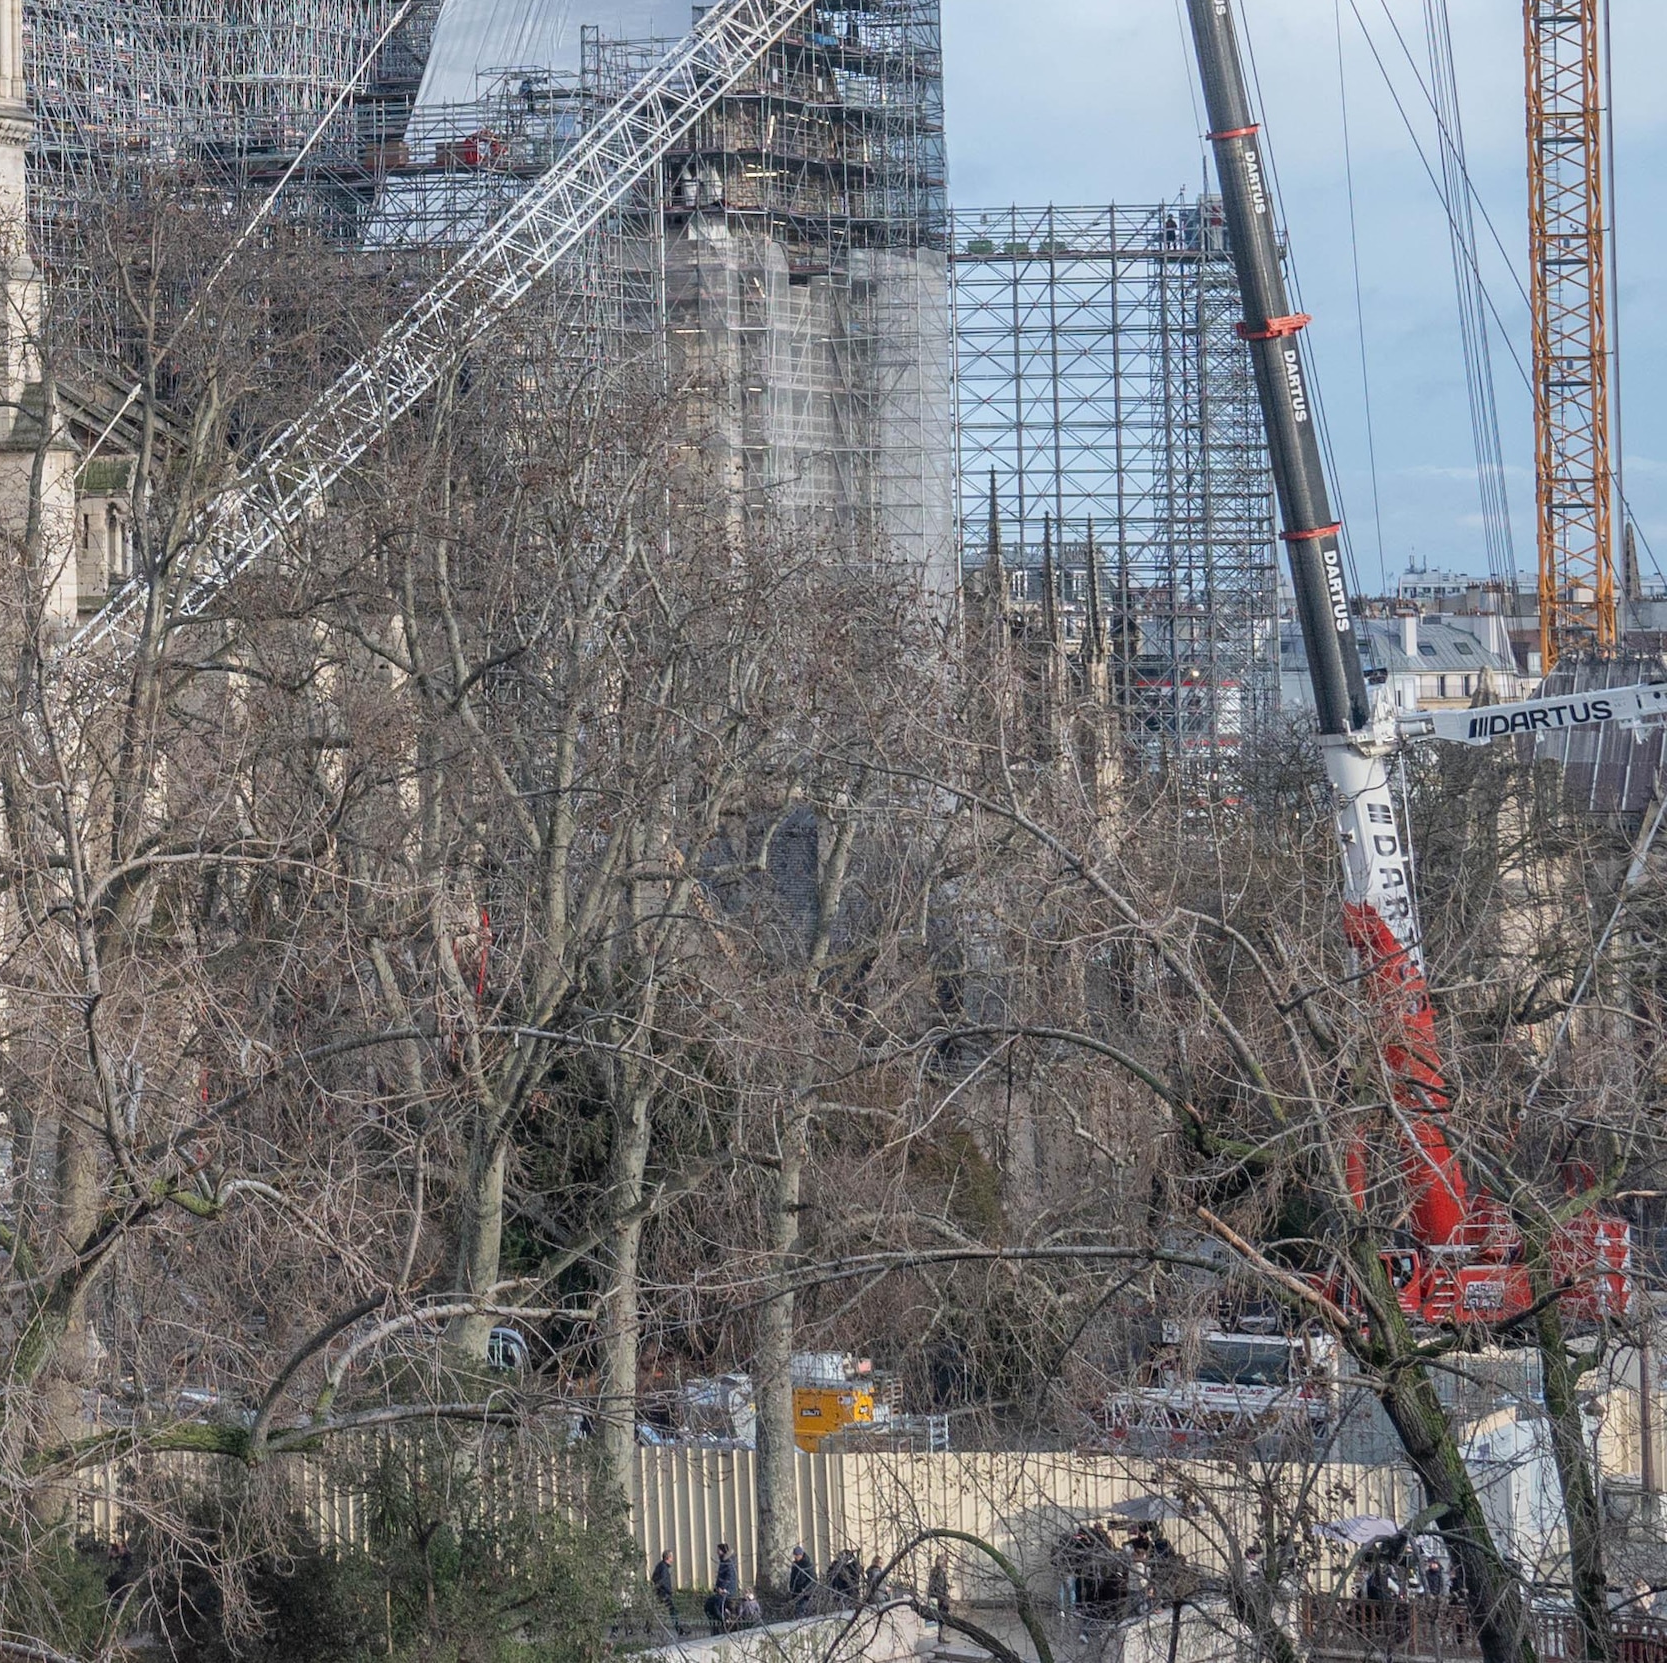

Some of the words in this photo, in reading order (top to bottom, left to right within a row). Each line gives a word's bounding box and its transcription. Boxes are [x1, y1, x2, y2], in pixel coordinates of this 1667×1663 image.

[1244, 150, 1266, 215] DARTUS
[1283, 349, 1308, 423] DARTUS
[1323, 549, 1350, 632] DARTUS
[1488, 700, 1613, 736] DARTUS
